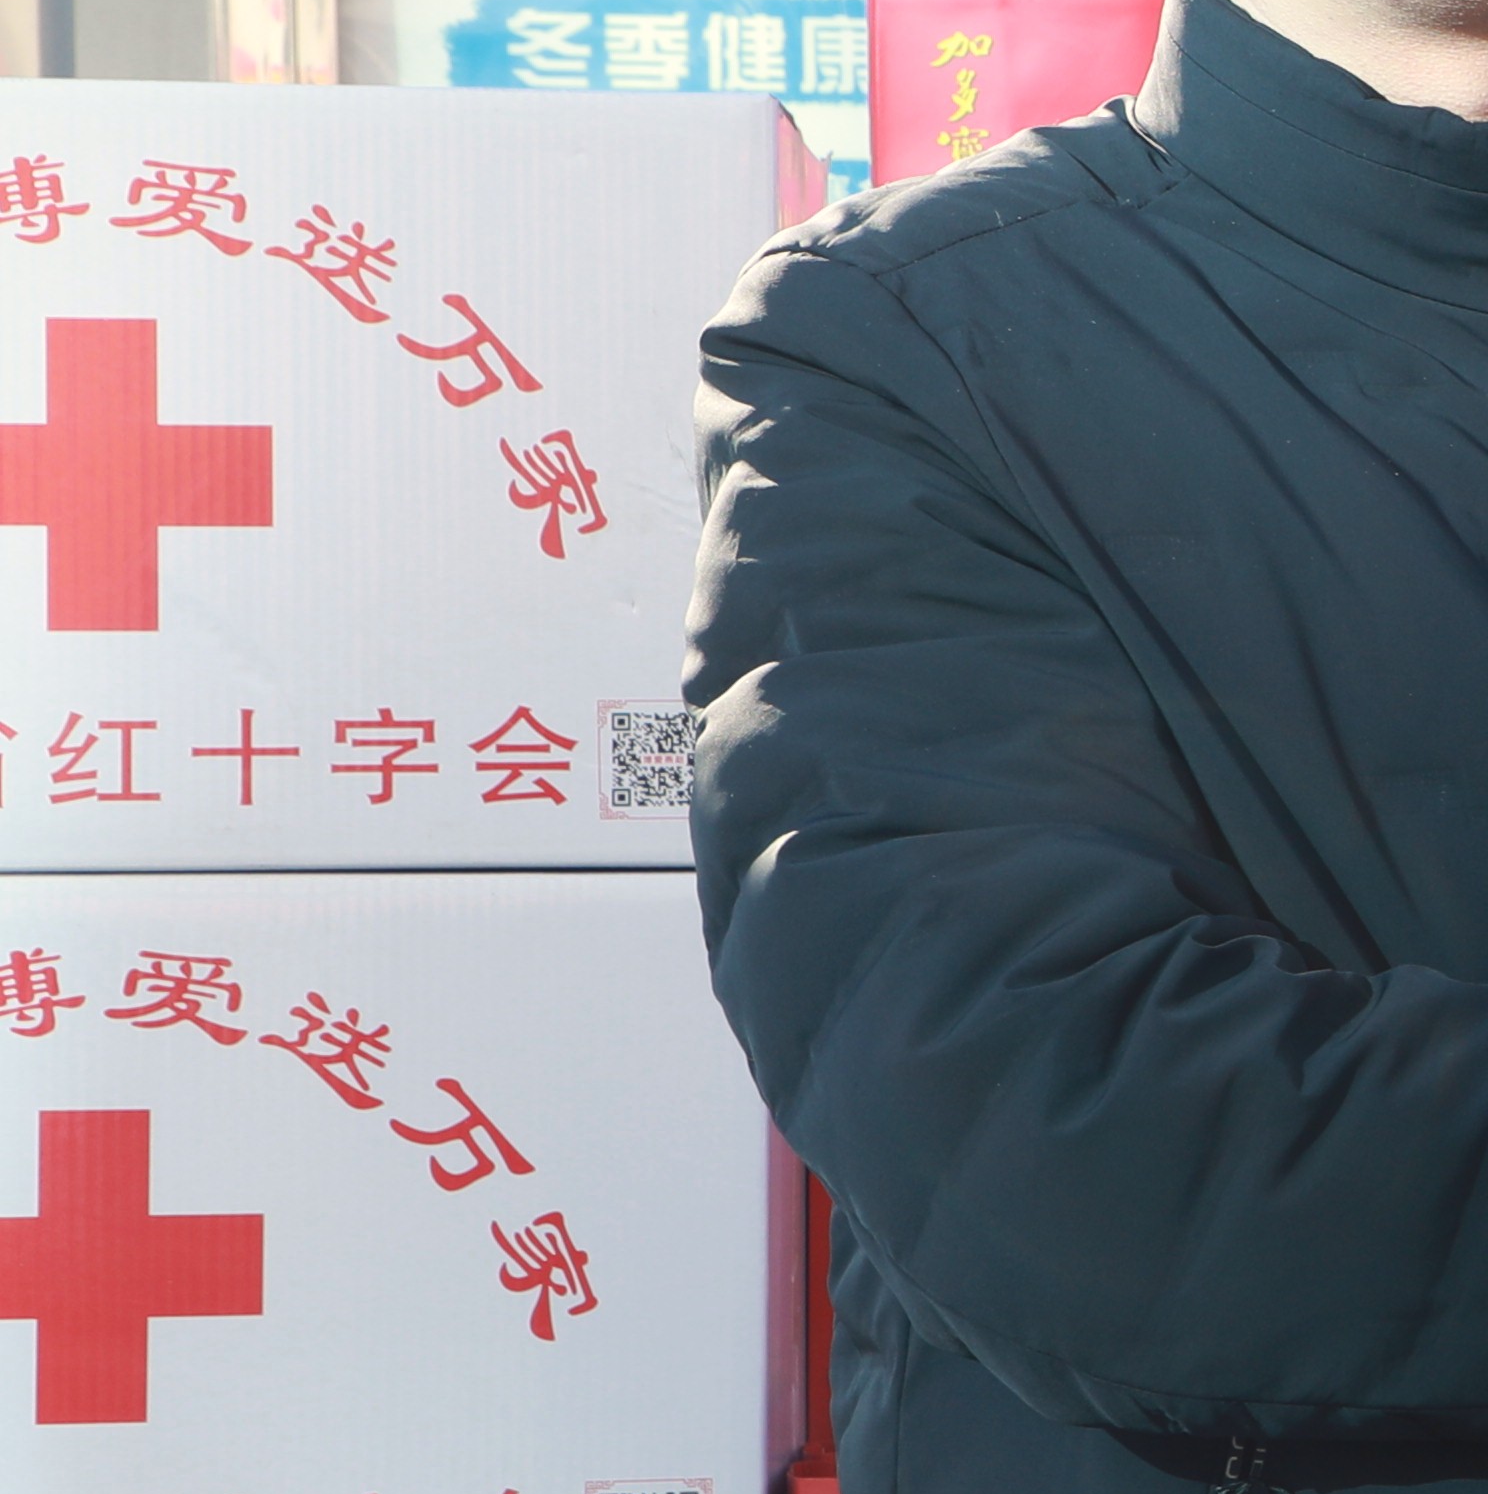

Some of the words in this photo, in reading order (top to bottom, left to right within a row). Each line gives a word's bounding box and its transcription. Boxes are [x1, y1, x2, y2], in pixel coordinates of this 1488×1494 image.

[506, 8, 868, 93] 冬季健康
[0, 705, 579, 806] 红十字会
